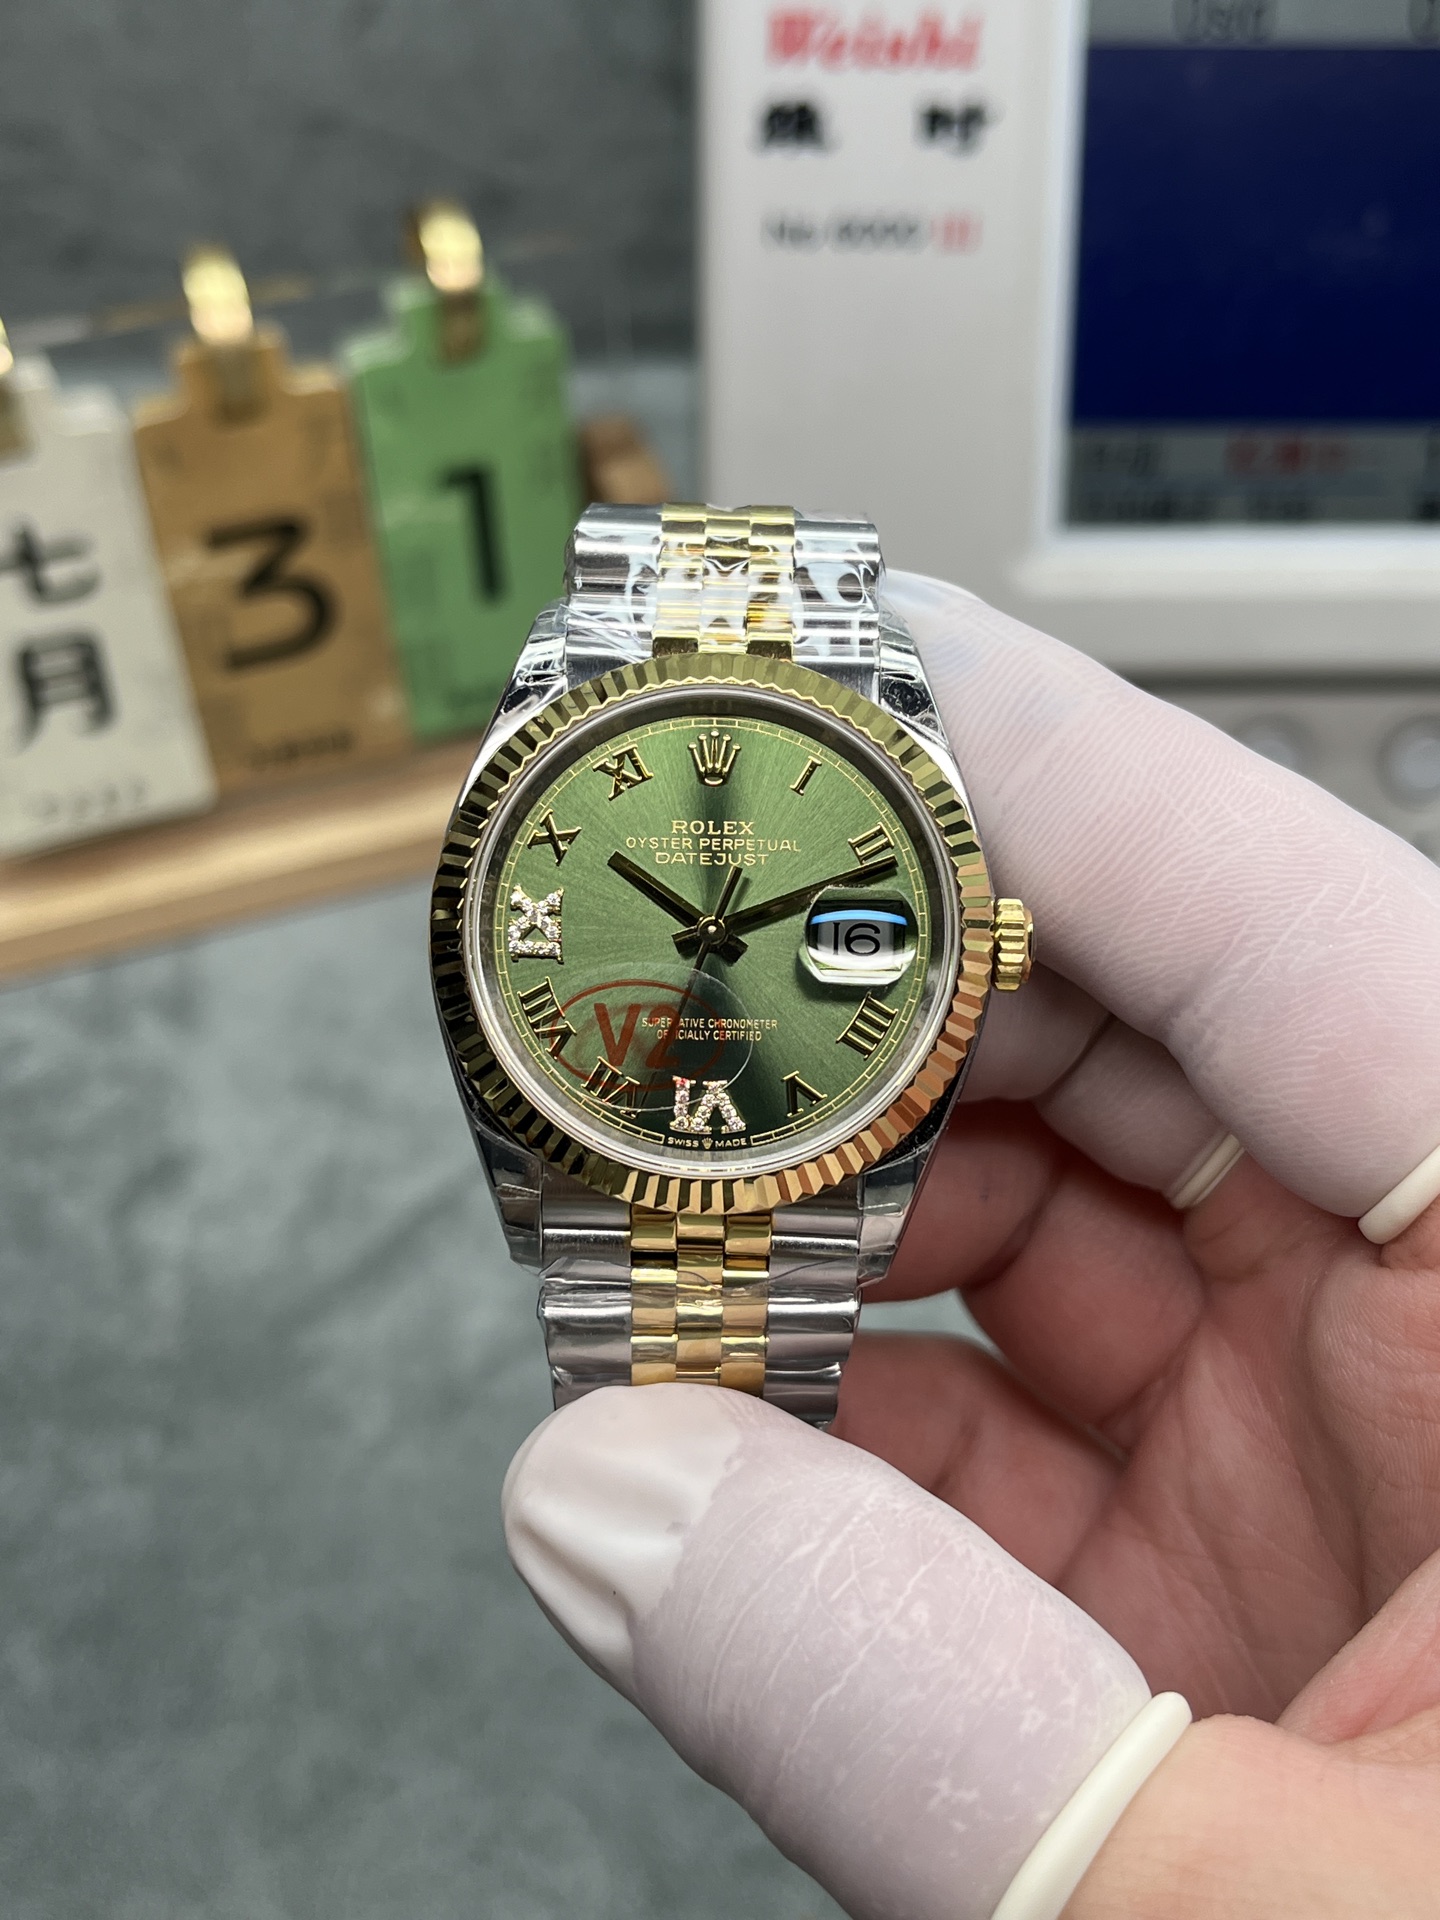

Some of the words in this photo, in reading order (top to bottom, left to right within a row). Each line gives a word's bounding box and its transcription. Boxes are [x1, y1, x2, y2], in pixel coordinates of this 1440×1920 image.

[442, 466, 506, 602] 1
[203, 518, 335, 672] 3
[671, 820, 755, 836] ROLEX
[625, 836, 693, 850] OYSTER
[699, 837, 802, 852] PERPETUAL
[655, 852, 769, 866] DATEJUST
[832, 920, 881, 957] 16
[641, 1017, 705, 1029] SUPERATIVE
[707, 1018, 778, 1030] CHRONOMETER
[712, 1030, 762, 1041] CERTIFIED
[667, 1136, 699, 1148] SWISS
[715, 1137, 747, 1148] MADE
